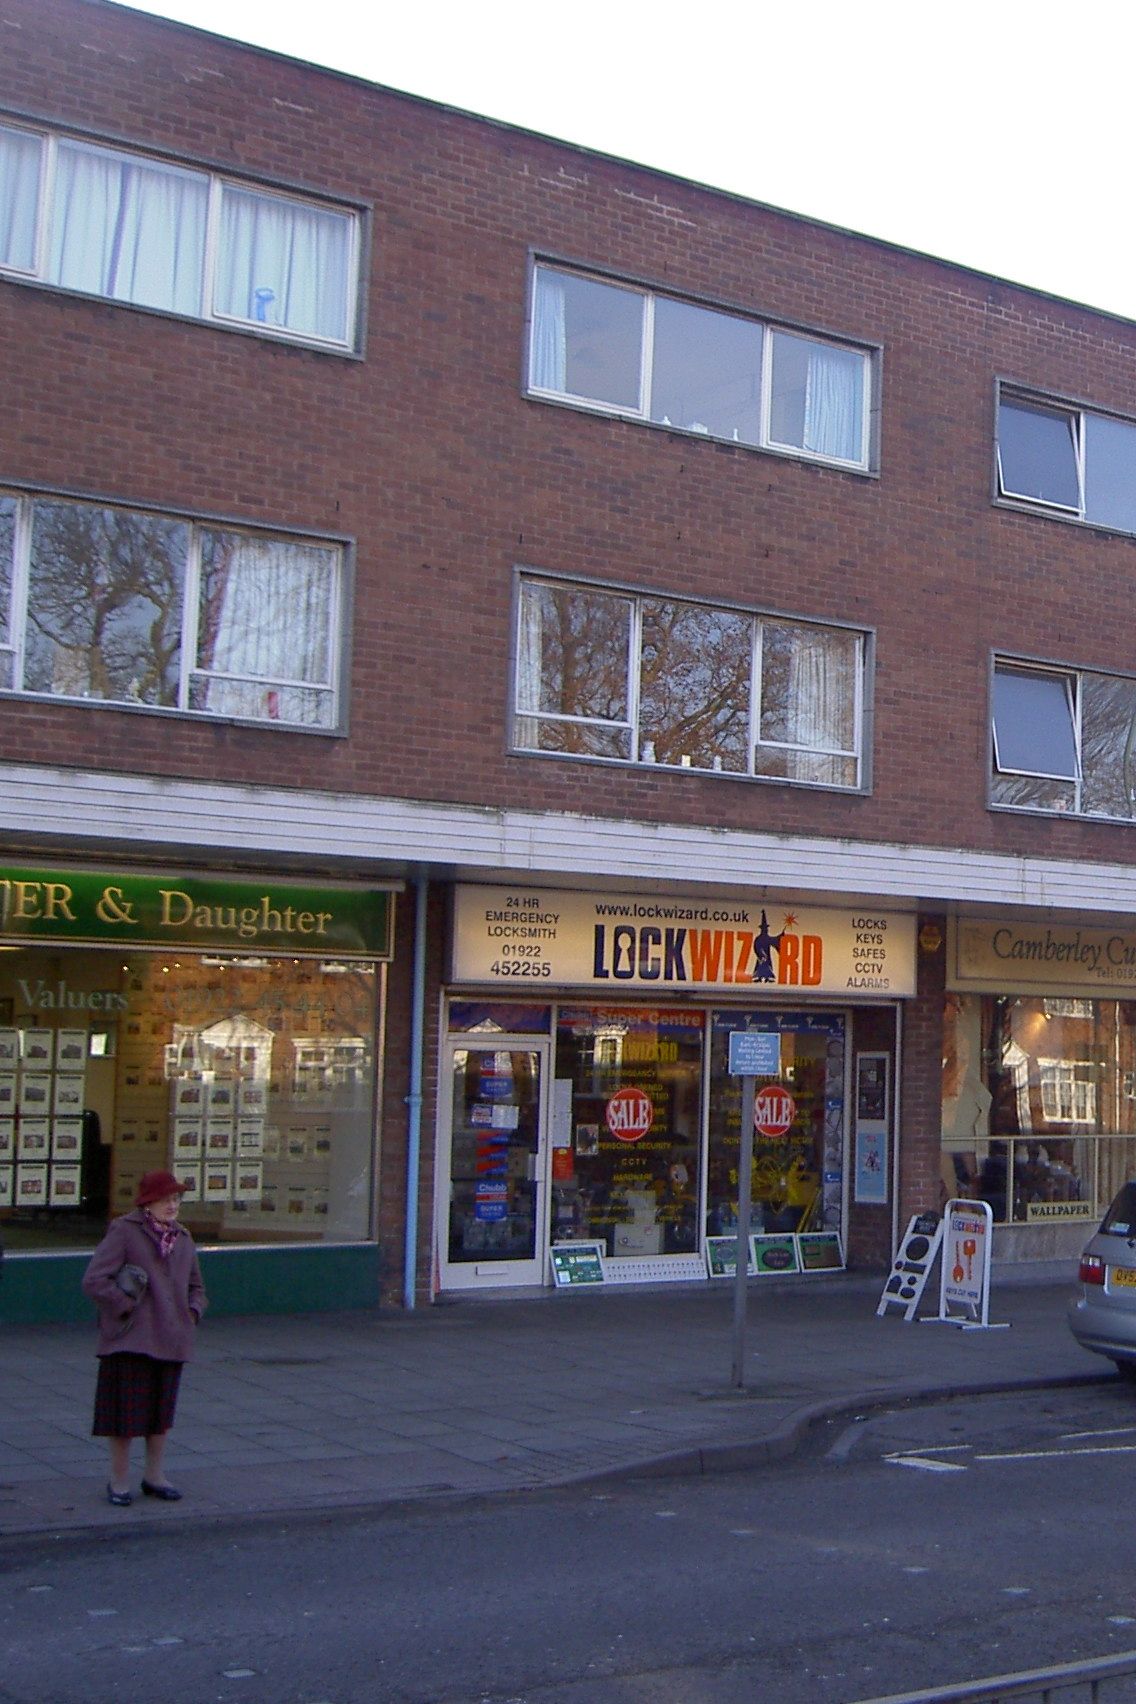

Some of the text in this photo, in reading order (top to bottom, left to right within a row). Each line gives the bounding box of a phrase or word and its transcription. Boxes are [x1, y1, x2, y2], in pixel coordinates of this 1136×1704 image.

[506, 897, 540, 909] 24 HR
[96, 886, 139, 924] &
[158, 889, 333, 937] Daughter
[485, 910, 560, 924] EMERGENCY
[595, 903, 749, 923] www.lockwizard.co.uk
[852, 917, 887, 930] LOCKS
[487, 926, 557, 939] LOCKSMITH
[856, 932, 883, 944] KEYS
[502, 944, 541, 957] 01922
[852, 947, 886, 959] SAFES
[992, 928, 1101, 971] Camberley
[490, 961, 551, 977] 452255
[855, 962, 883, 974] CCTV
[846, 977, 890, 989] ALARMS
[18, 979, 129, 1010] Valuers
[649, 1011, 700, 1027] Centre
[607, 1098, 651, 1130] SALE
[753, 1096, 792, 1126] SALE
[1030, 1203, 1091, 1218] WALLPAPER
